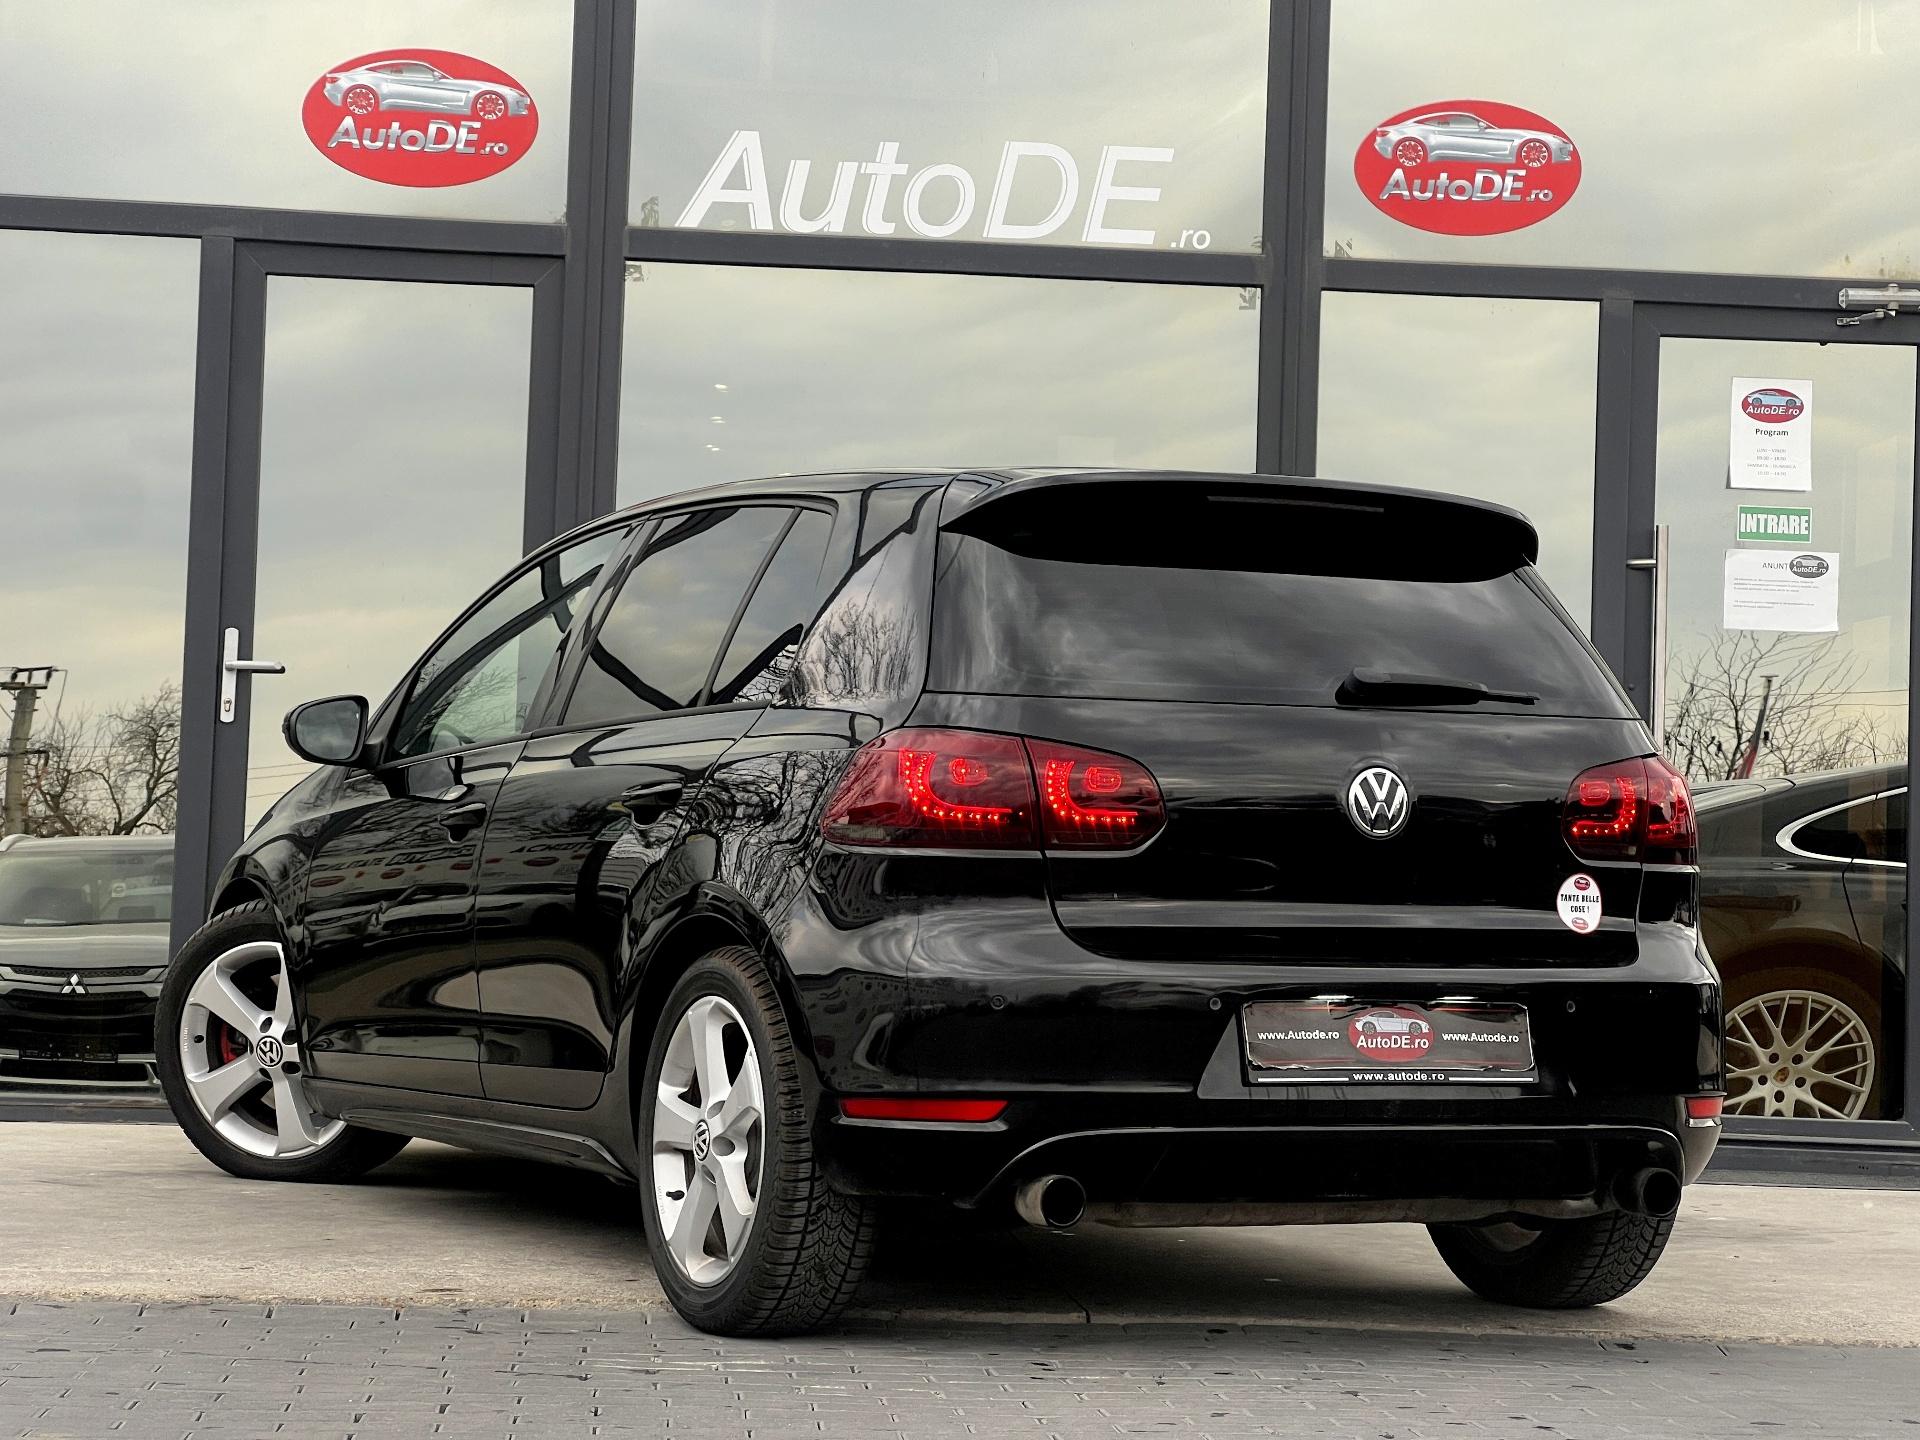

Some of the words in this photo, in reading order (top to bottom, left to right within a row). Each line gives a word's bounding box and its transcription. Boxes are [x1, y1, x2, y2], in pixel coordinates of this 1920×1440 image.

[1746, 405, 1800, 416] AutoDE.ro
[1755, 428, 1789, 437] Program
[1740, 513, 1809, 535] INTRARE
[1561, 894, 1579, 902] TANTE
[1581, 894, 1600, 903] BELLE
[1257, 1030, 1340, 1041] www.Autode.ro
[1442, 1032, 1519, 1043] www.Autode.ro
[1356, 1035, 1429, 1050] AutoDE.ro
[1353, 1071, 1445, 1081] www.autode.ro
